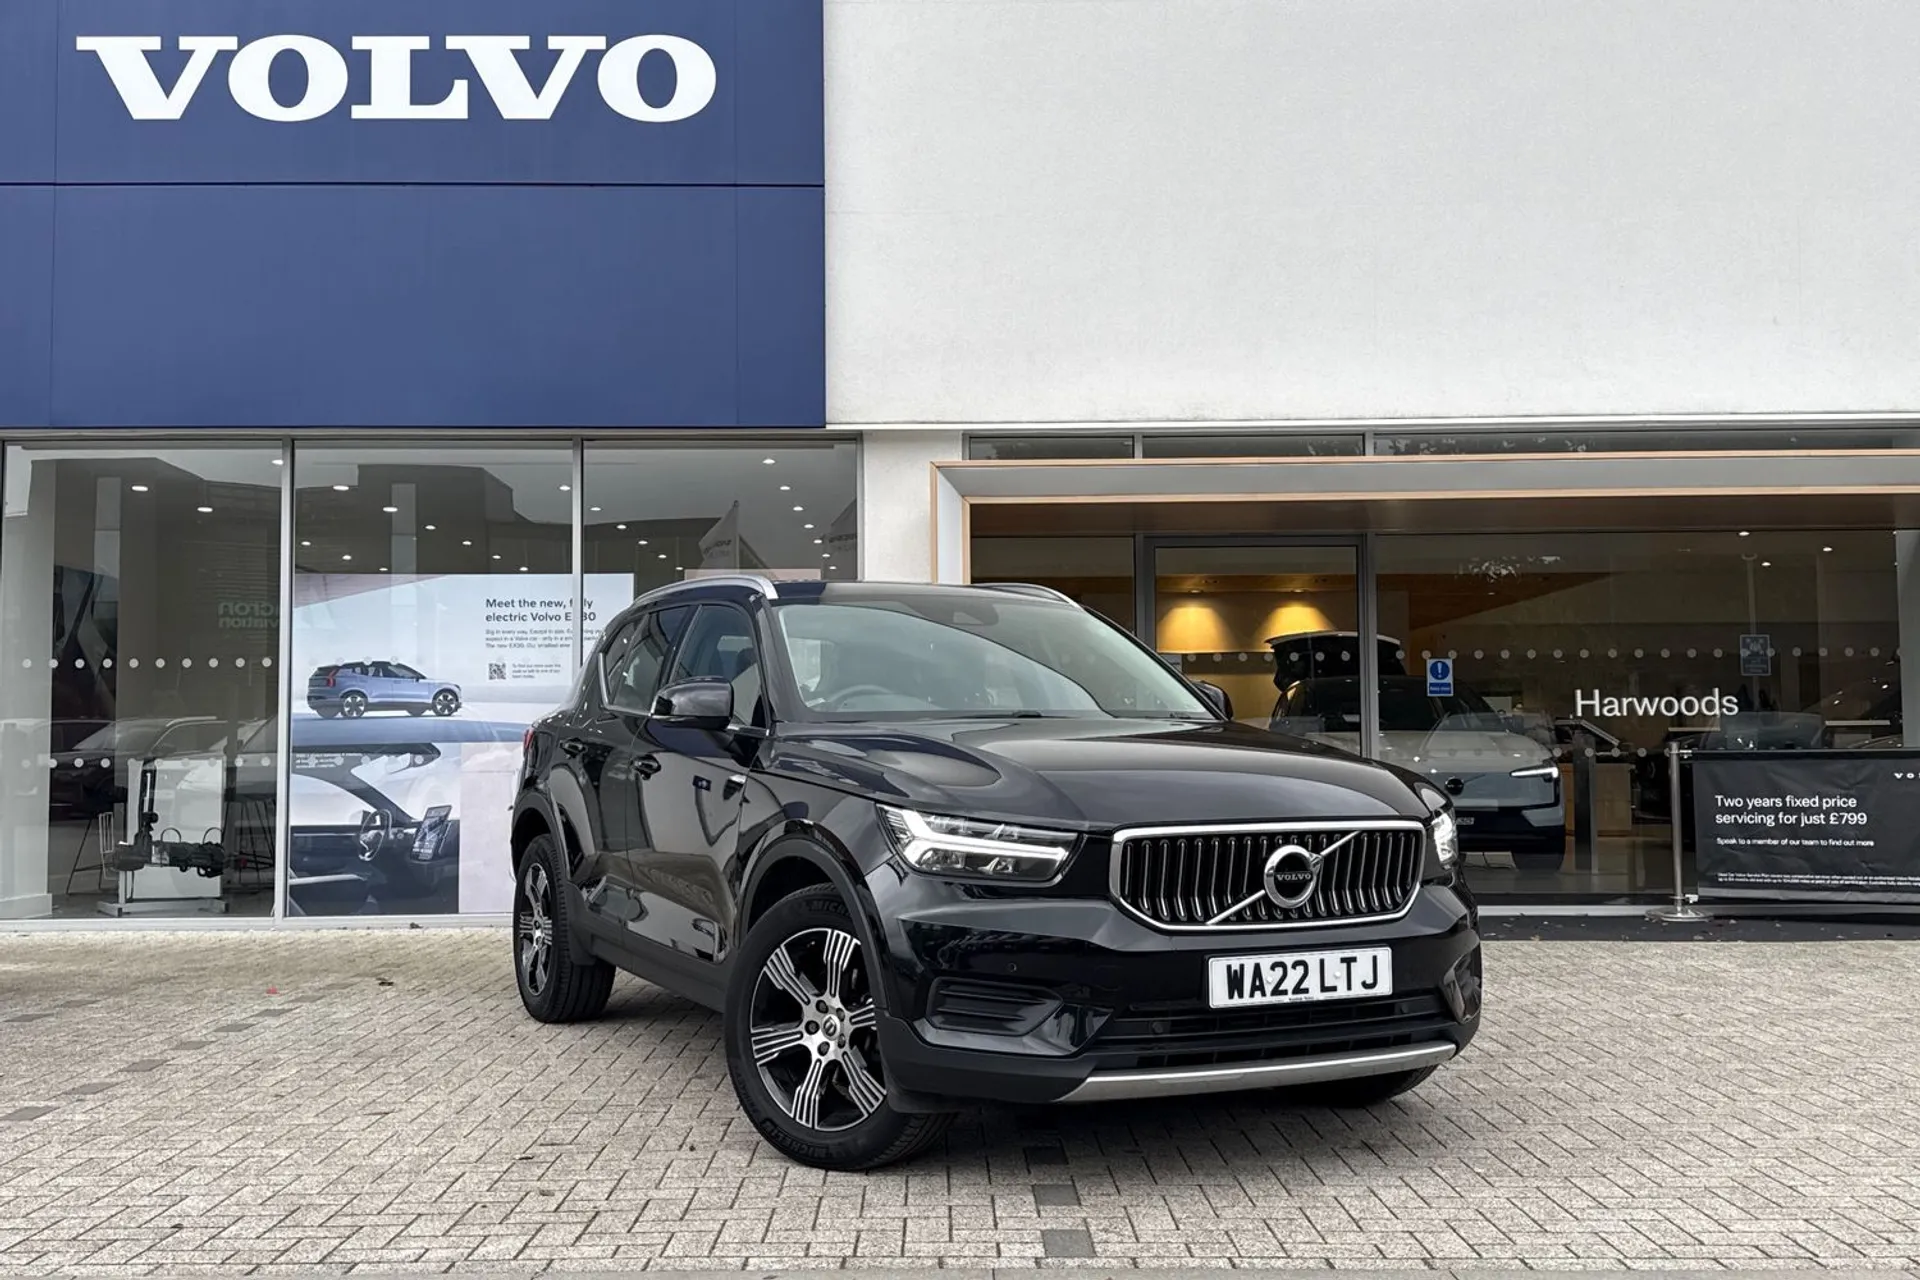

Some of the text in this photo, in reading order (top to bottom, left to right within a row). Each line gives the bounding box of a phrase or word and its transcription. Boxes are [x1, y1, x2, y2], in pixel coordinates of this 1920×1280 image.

[76, 34, 717, 123] VOLVO
[485, 598, 594, 610] Meet the new, fly
[485, 611, 597, 622] electric Volvo E30
[1575, 687, 1739, 717] Harwoods
[1715, 794, 1857, 810] Two years fixed price
[1715, 811, 1868, 827] servicing for just £799
[1717, 837, 1738, 846] Speak
[1829, 838, 1843, 846] find
[1276, 873, 1311, 881] VOLVO
[1226, 955, 1379, 1000] WA22 LTJ
